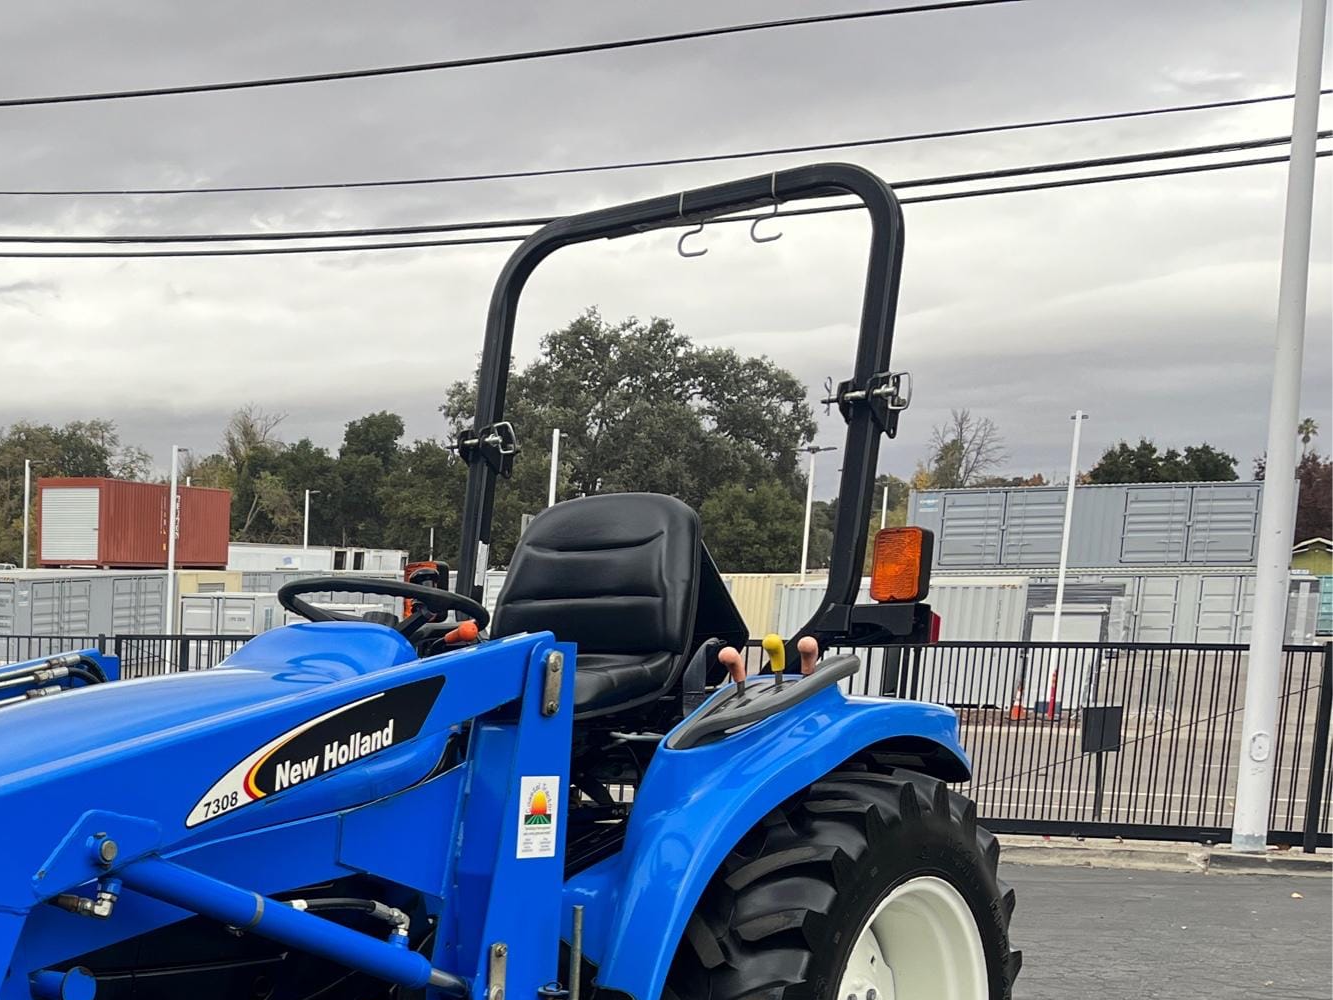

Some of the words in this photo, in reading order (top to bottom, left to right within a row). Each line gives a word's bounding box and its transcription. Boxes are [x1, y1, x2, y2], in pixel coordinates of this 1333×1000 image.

[274, 755, 319, 792] New
[323, 718, 394, 772] Holland
[203, 790, 238, 818] 7308
